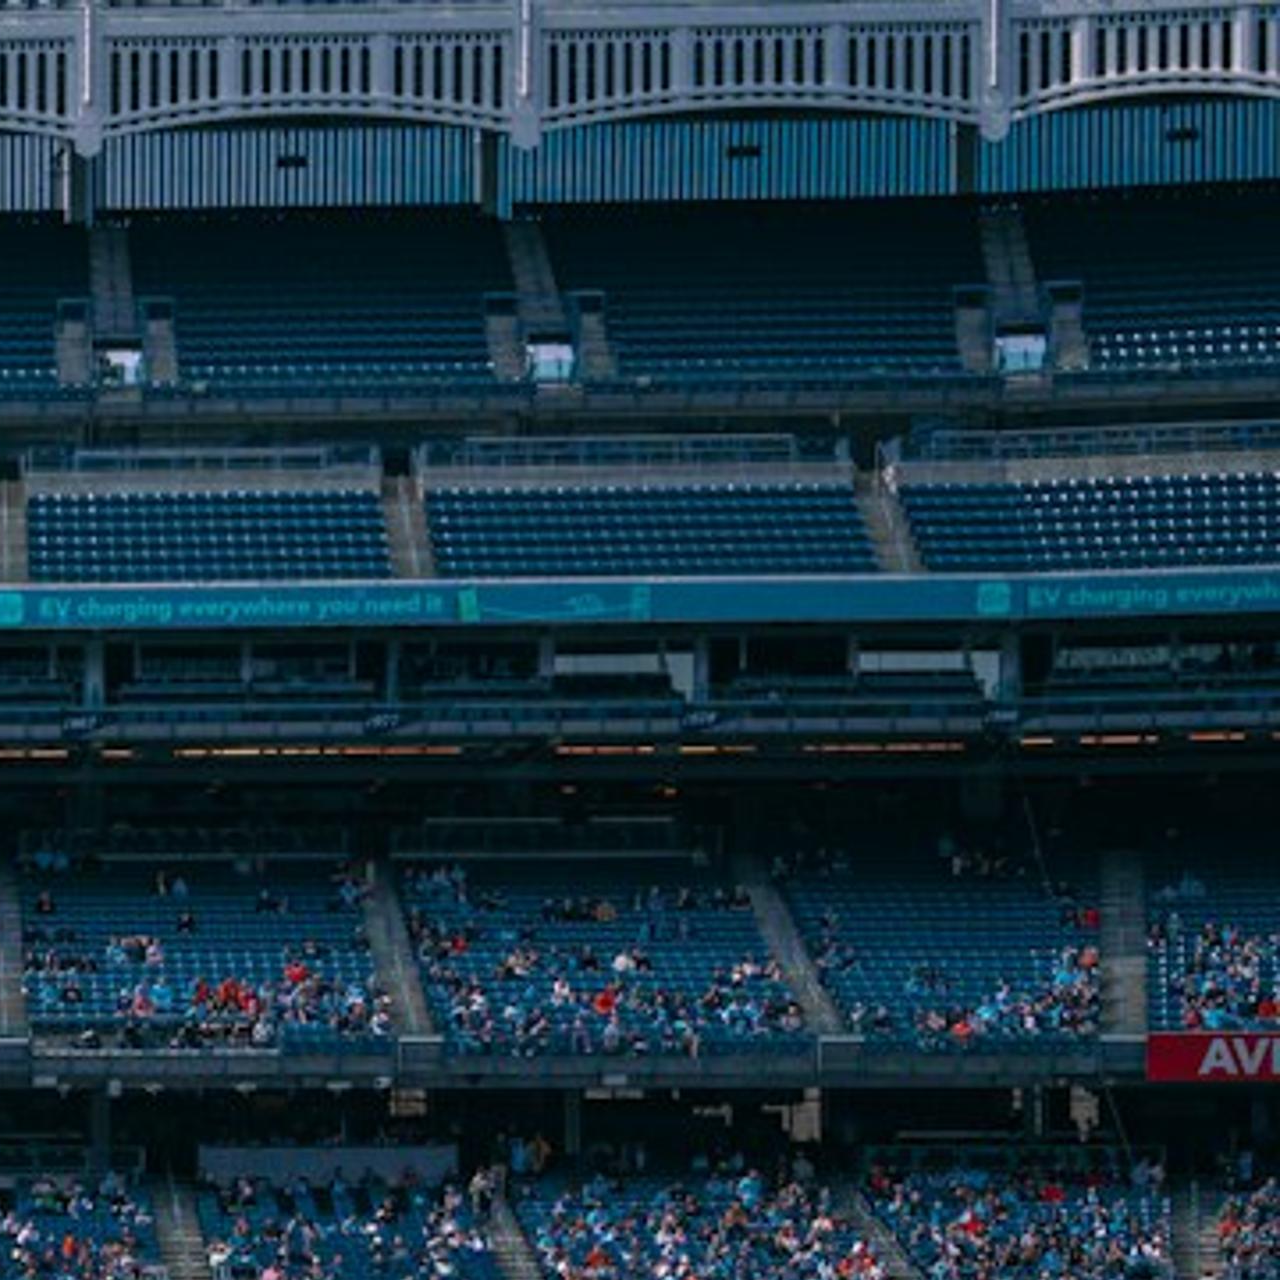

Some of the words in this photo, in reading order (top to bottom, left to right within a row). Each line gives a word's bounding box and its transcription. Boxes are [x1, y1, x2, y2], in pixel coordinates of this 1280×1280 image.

[42, 597, 72, 618] EV
[78, 596, 171, 623] charging
[317, 600, 359, 621] you
